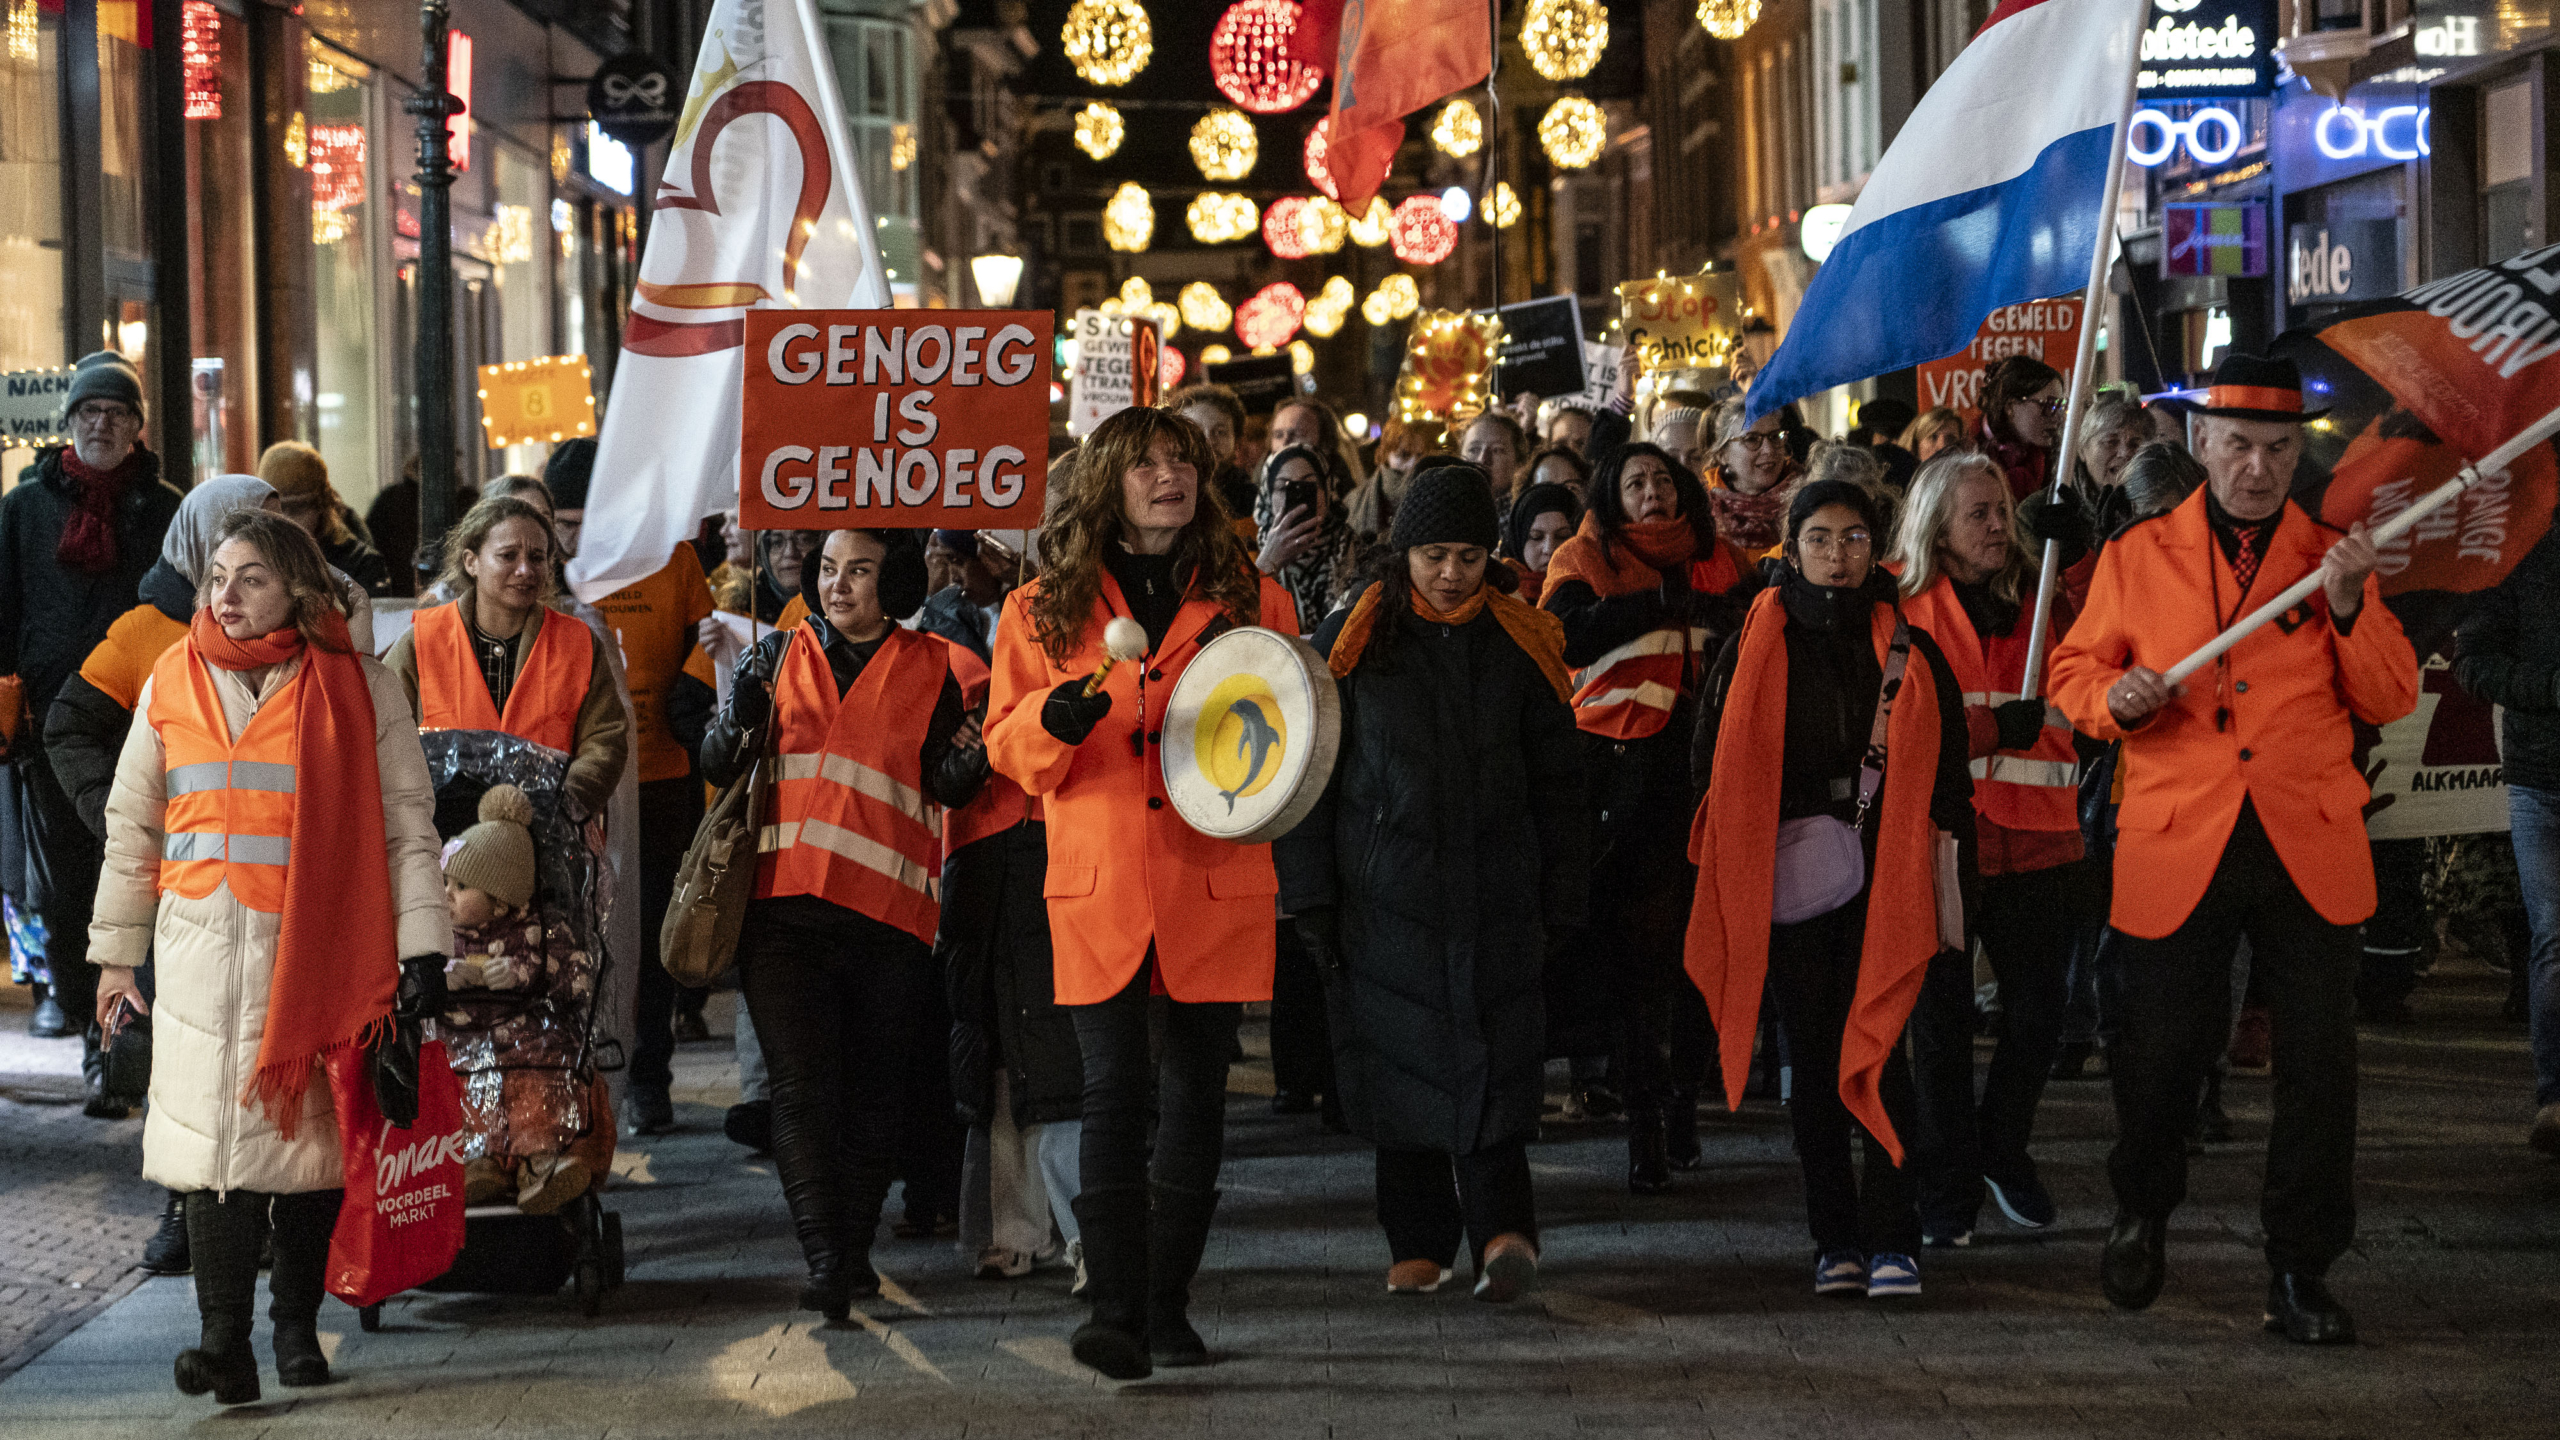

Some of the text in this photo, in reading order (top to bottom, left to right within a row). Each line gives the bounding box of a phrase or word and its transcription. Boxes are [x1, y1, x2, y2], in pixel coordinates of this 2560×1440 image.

[1639, 284, 1718, 330] Stop
[1988, 304, 2074, 333] GEWELD
[768, 322, 1037, 387] GENOEG
[1971, 336, 2044, 361] TEGEN
[1602, 365, 1618, 382] IS
[527, 390, 543, 416] 8
[11, 419, 50, 434] VAN
[874, 390, 940, 447] IS
[761, 445, 1027, 510] GENOEG
[377, 1183, 452, 1215] VOORDEEL
[390, 1203, 437, 1229] MARKT
